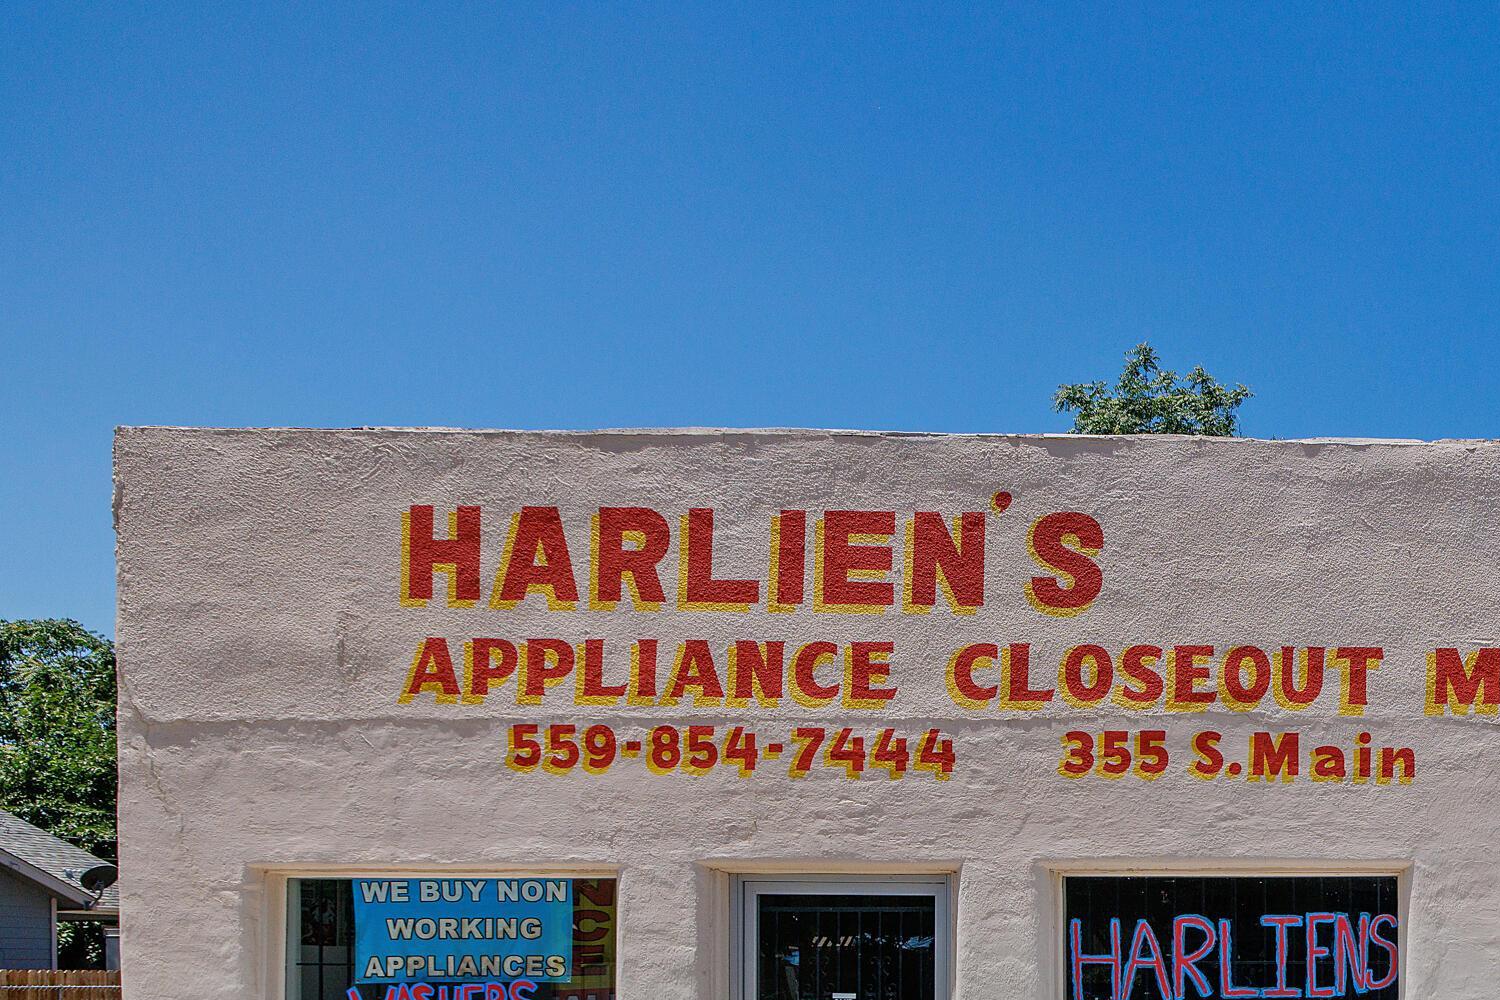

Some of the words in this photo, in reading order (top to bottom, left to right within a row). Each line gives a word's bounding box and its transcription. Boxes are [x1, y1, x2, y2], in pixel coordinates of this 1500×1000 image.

[400, 491, 1106, 618] HARLIEN'S
[399, 636, 899, 707] APPLIANCE
[945, 642, 1385, 716] CLOSEOUT
[506, 722, 957, 780] 559-854-7444
[1058, 729, 1170, 781] 355
[360, 880, 409, 904] WE
[418, 880, 487, 904] BUY
[496, 880, 569, 903] NON
[385, 917, 544, 941] WORKING
[364, 954, 567, 978] APPLIANCES
